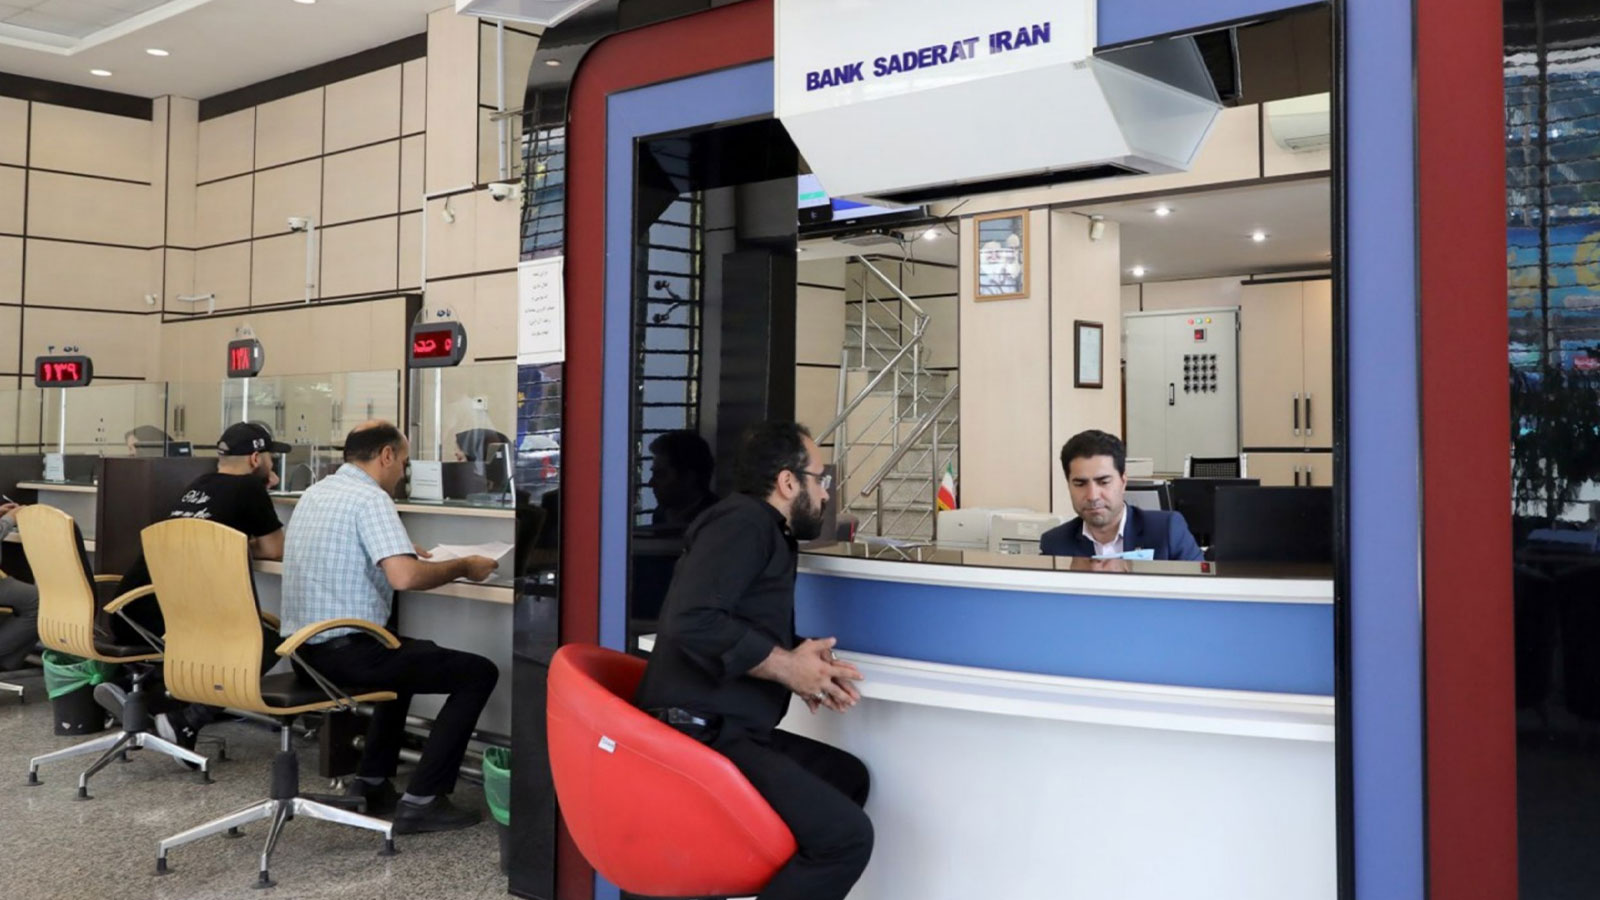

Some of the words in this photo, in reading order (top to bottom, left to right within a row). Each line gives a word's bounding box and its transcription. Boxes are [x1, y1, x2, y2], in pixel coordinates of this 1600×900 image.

[805, 61, 864, 91] BANK
[873, 37, 980, 78] SADERAT
[989, 21, 1051, 54] IRAN
[43, 362, 79, 381] ۱۳۹
